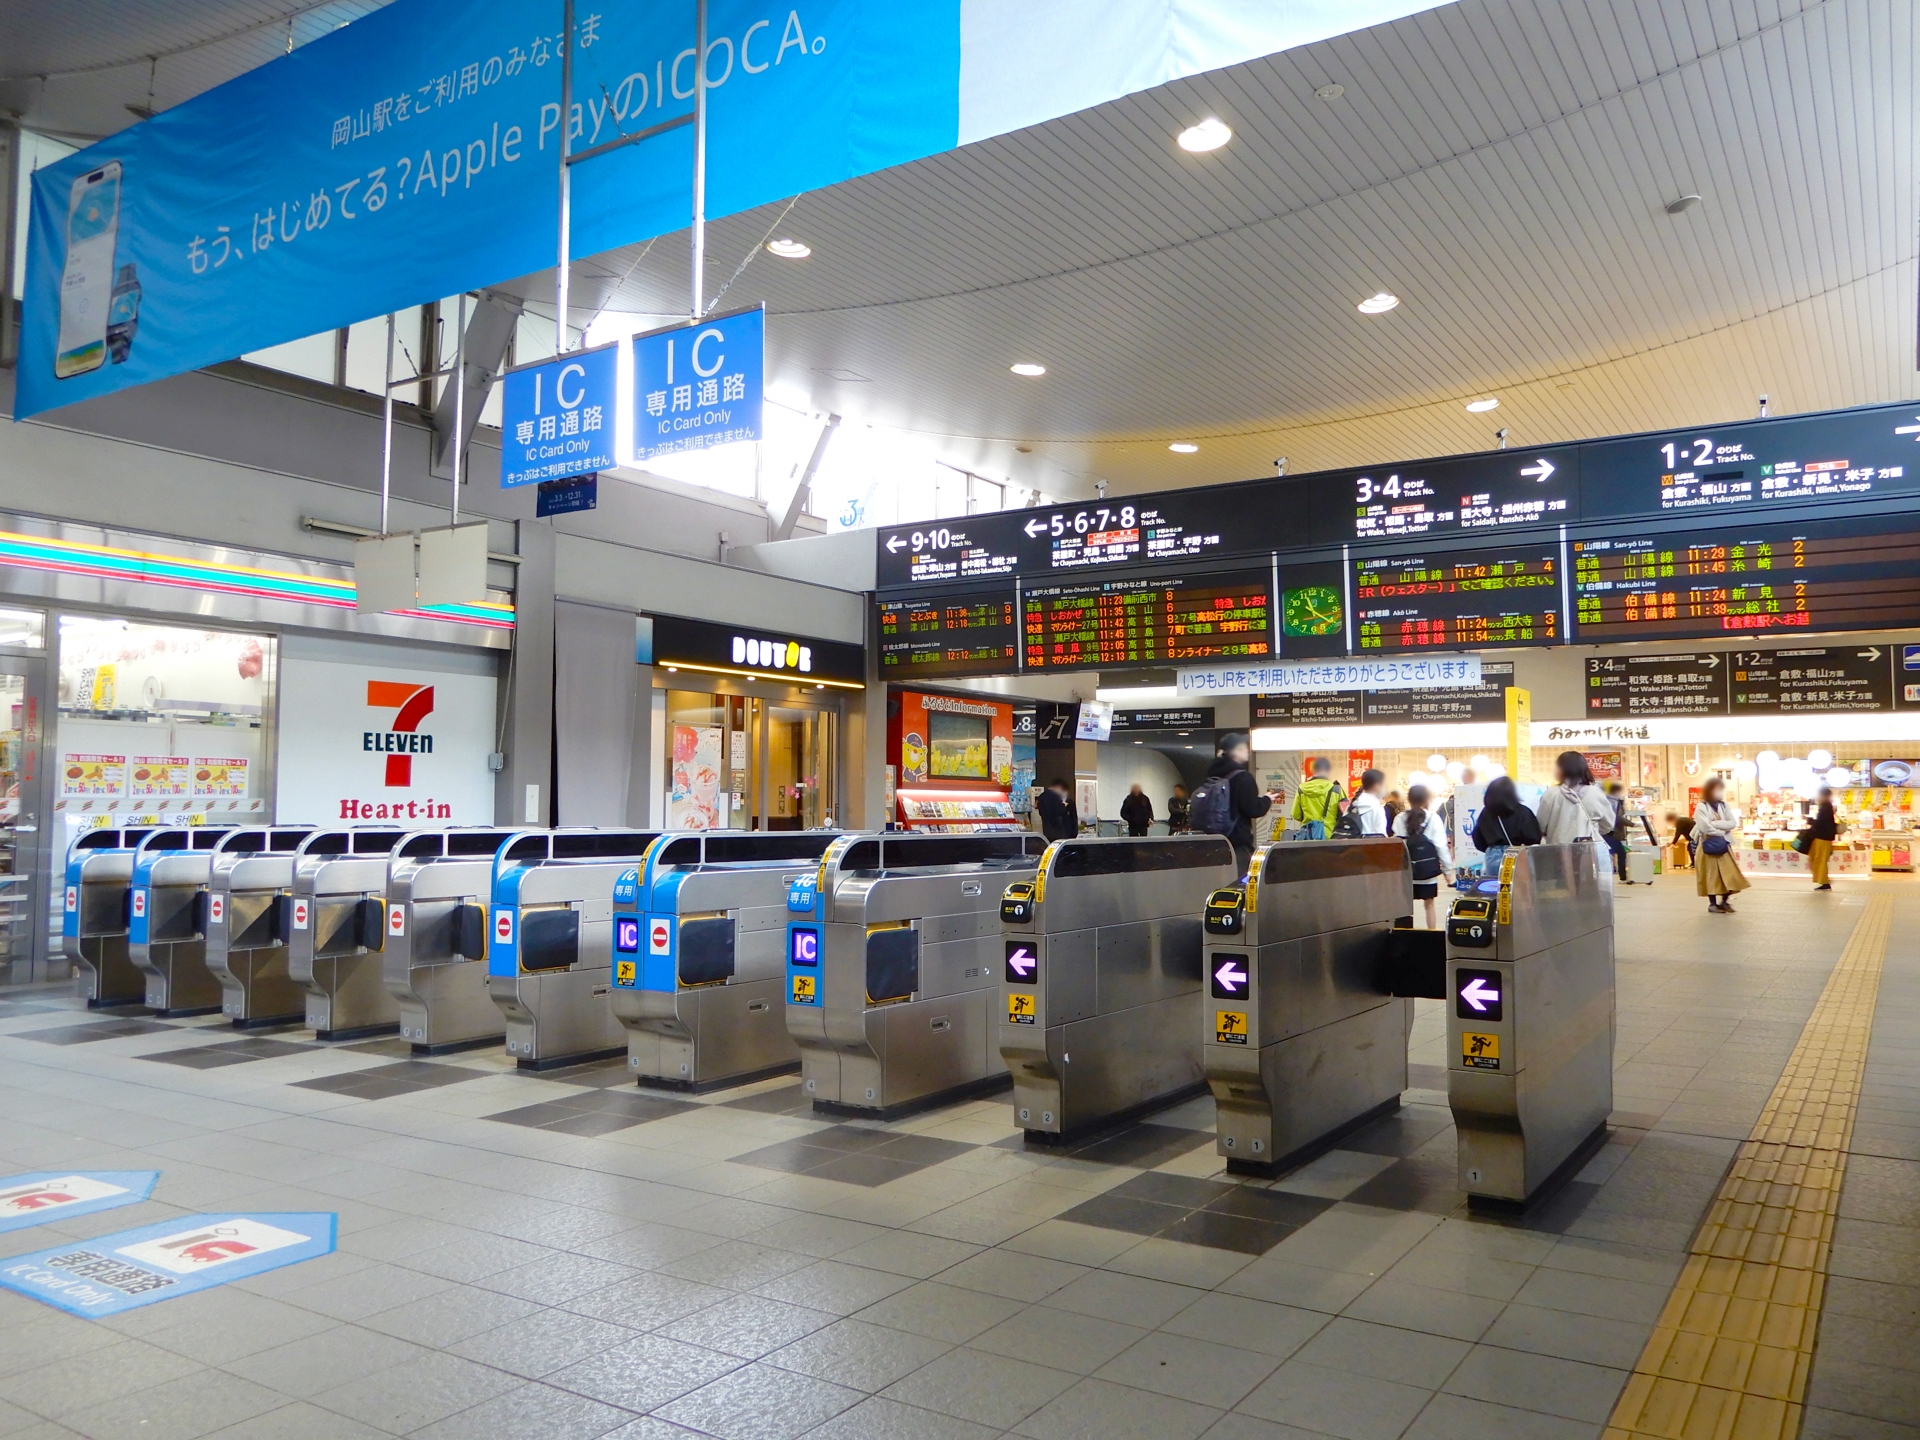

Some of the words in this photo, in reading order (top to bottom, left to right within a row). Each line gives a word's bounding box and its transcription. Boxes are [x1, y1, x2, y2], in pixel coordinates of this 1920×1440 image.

[667, 328, 725, 385] IC
[534, 364, 586, 415] IC
[645, 373, 746, 417] 専用通路
[515, 405, 603, 445] 専用通路
[658, 420, 670, 434] IC
[673, 414, 701, 432] Card
[704, 409, 731, 427] Only
[526, 448, 537, 461] IC
[539, 443, 564, 458] Card
[566, 439, 590, 456] Only
[637, 427, 755, 459] きっぷはご利用できません
[1716, 444, 1743, 454] のりば
[1716, 453, 1738, 464] Track
[1740, 452, 1755, 462] No.
[507, 454, 610, 484] きっぷはご利用できません
[1403, 480, 1425, 489] のりば
[1403, 488, 1422, 498] Track
[1423, 488, 1435, 496] No.
[1775, 487, 1814, 498] Kurashiki,
[1674, 497, 1711, 508] Kurashiki,
[1713, 493, 1752, 504] Fukuyama
[1140, 511, 1158, 519] のりば
[1140, 518, 1156, 526] Track
[1472, 516, 1497, 527] Saidaiji,
[1367, 527, 1386, 537] Wake,
[951, 540, 963, 548] Track
[1156, 547, 1187, 557] Chayamachi,
[1188, 546, 1200, 554] Uno
[1584, 541, 1611, 551] 山陽線
[1638, 539, 1653, 547] Line
[1060, 556, 1089, 567] Chayamachi,
[1575, 557, 1600, 570] 普通
[1623, 551, 1674, 567] 山陽線
[1687, 547, 1725, 561] 11:29
[1730, 544, 1772, 559] 金光
[1794, 541, 1804, 554] 2
[1365, 559, 1388, 569] 山陽線
[1576, 570, 1600, 583] 普通
[1624, 564, 1675, 580] 山陽線
[1688, 561, 1726, 575] 11:45
[1730, 557, 1772, 573] 糸崎
[1794, 555, 1804, 568] 2
[1359, 574, 1380, 586] 普通
[1400, 570, 1443, 583] 山陽線
[1454, 566, 1486, 579] 11:42
[1490, 563, 1525, 576] 瀬戸
[1543, 561, 1552, 572] 4
[1458, 575, 1555, 591] でご確認ください。
[1616, 581, 1640, 589] Hakubi
[1099, 595, 1123, 606] 11:23
[1166, 591, 1174, 601] 8
[1576, 597, 1601, 611] 普通
[1625, 592, 1676, 607] 伯備線
[1689, 588, 1727, 602] 11:24
[1731, 586, 1773, 601] 新見
[1795, 584, 1805, 597] 2
[910, 611, 939, 622] ことぶき
[1004, 604, 1012, 614] 9
[1050, 609, 1083, 621] しおかぜ
[1099, 606, 1124, 617] 11:35
[1127, 604, 1153, 616] 松山
[1166, 602, 1174, 613] 6
[1577, 611, 1602, 624] 普通
[1625, 606, 1677, 621] 伯備線
[1689, 603, 1727, 617] 11:39
[1745, 600, 1781, 614] 総社
[1795, 598, 1805, 611] 2
[1005, 615, 1012, 625] 9
[1082, 619, 1099, 630] 27号
[1100, 618, 1124, 628] 11:42
[1127, 616, 1154, 627] 高松
[1167, 614, 1174, 624] 8
[1360, 623, 1381, 635] 普通
[1401, 620, 1445, 633] 赤穂線
[1456, 617, 1487, 630] 11:24
[1503, 615, 1533, 628] 西大寺
[1545, 613, 1555, 625] 3
[1100, 629, 1124, 640] 11:45
[1128, 627, 1154, 638] 児島
[1168, 625, 1174, 633] 7
[1360, 636, 1382, 649] 普通
[1402, 632, 1446, 646] 赤穂線
[1457, 630, 1488, 643] 11:54
[1503, 628, 1534, 641] 長船
[1545, 626, 1555, 638] 4
[1054, 642, 1080, 654] 南風
[1100, 640, 1125, 651] 12:05
[1128, 638, 1154, 650] 高知
[1167, 636, 1175, 647] 6
[732, 636, 812, 672] DOUTOR
[947, 649, 969, 660] 12:12
[1005, 647, 1014, 657] 10
[1101, 652, 1125, 662] 12:13
[1128, 649, 1155, 661] 高松
[1168, 648, 1175, 658] 8
[1182, 660, 1476, 690] いつもJRをご利用いただきありがとうございます。
[1792, 679, 1868, 688] Kurashiki,Fukuyama
[921, 696, 997, 716] ふるさとInformation
[1548, 725, 1651, 741] おみやげ街道
[338, 798, 452, 819] Heart-in
[126, 815, 152, 825] SHIN
[175, 814, 200, 824] SHIN
[615, 885, 633, 897] 専用
[789, 892, 811, 905] 専用
[620, 923, 637, 947] IC
[796, 935, 817, 960] IC
[1228, 1138, 1234, 1147] 2
[1472, 1171, 1478, 1182] 1
